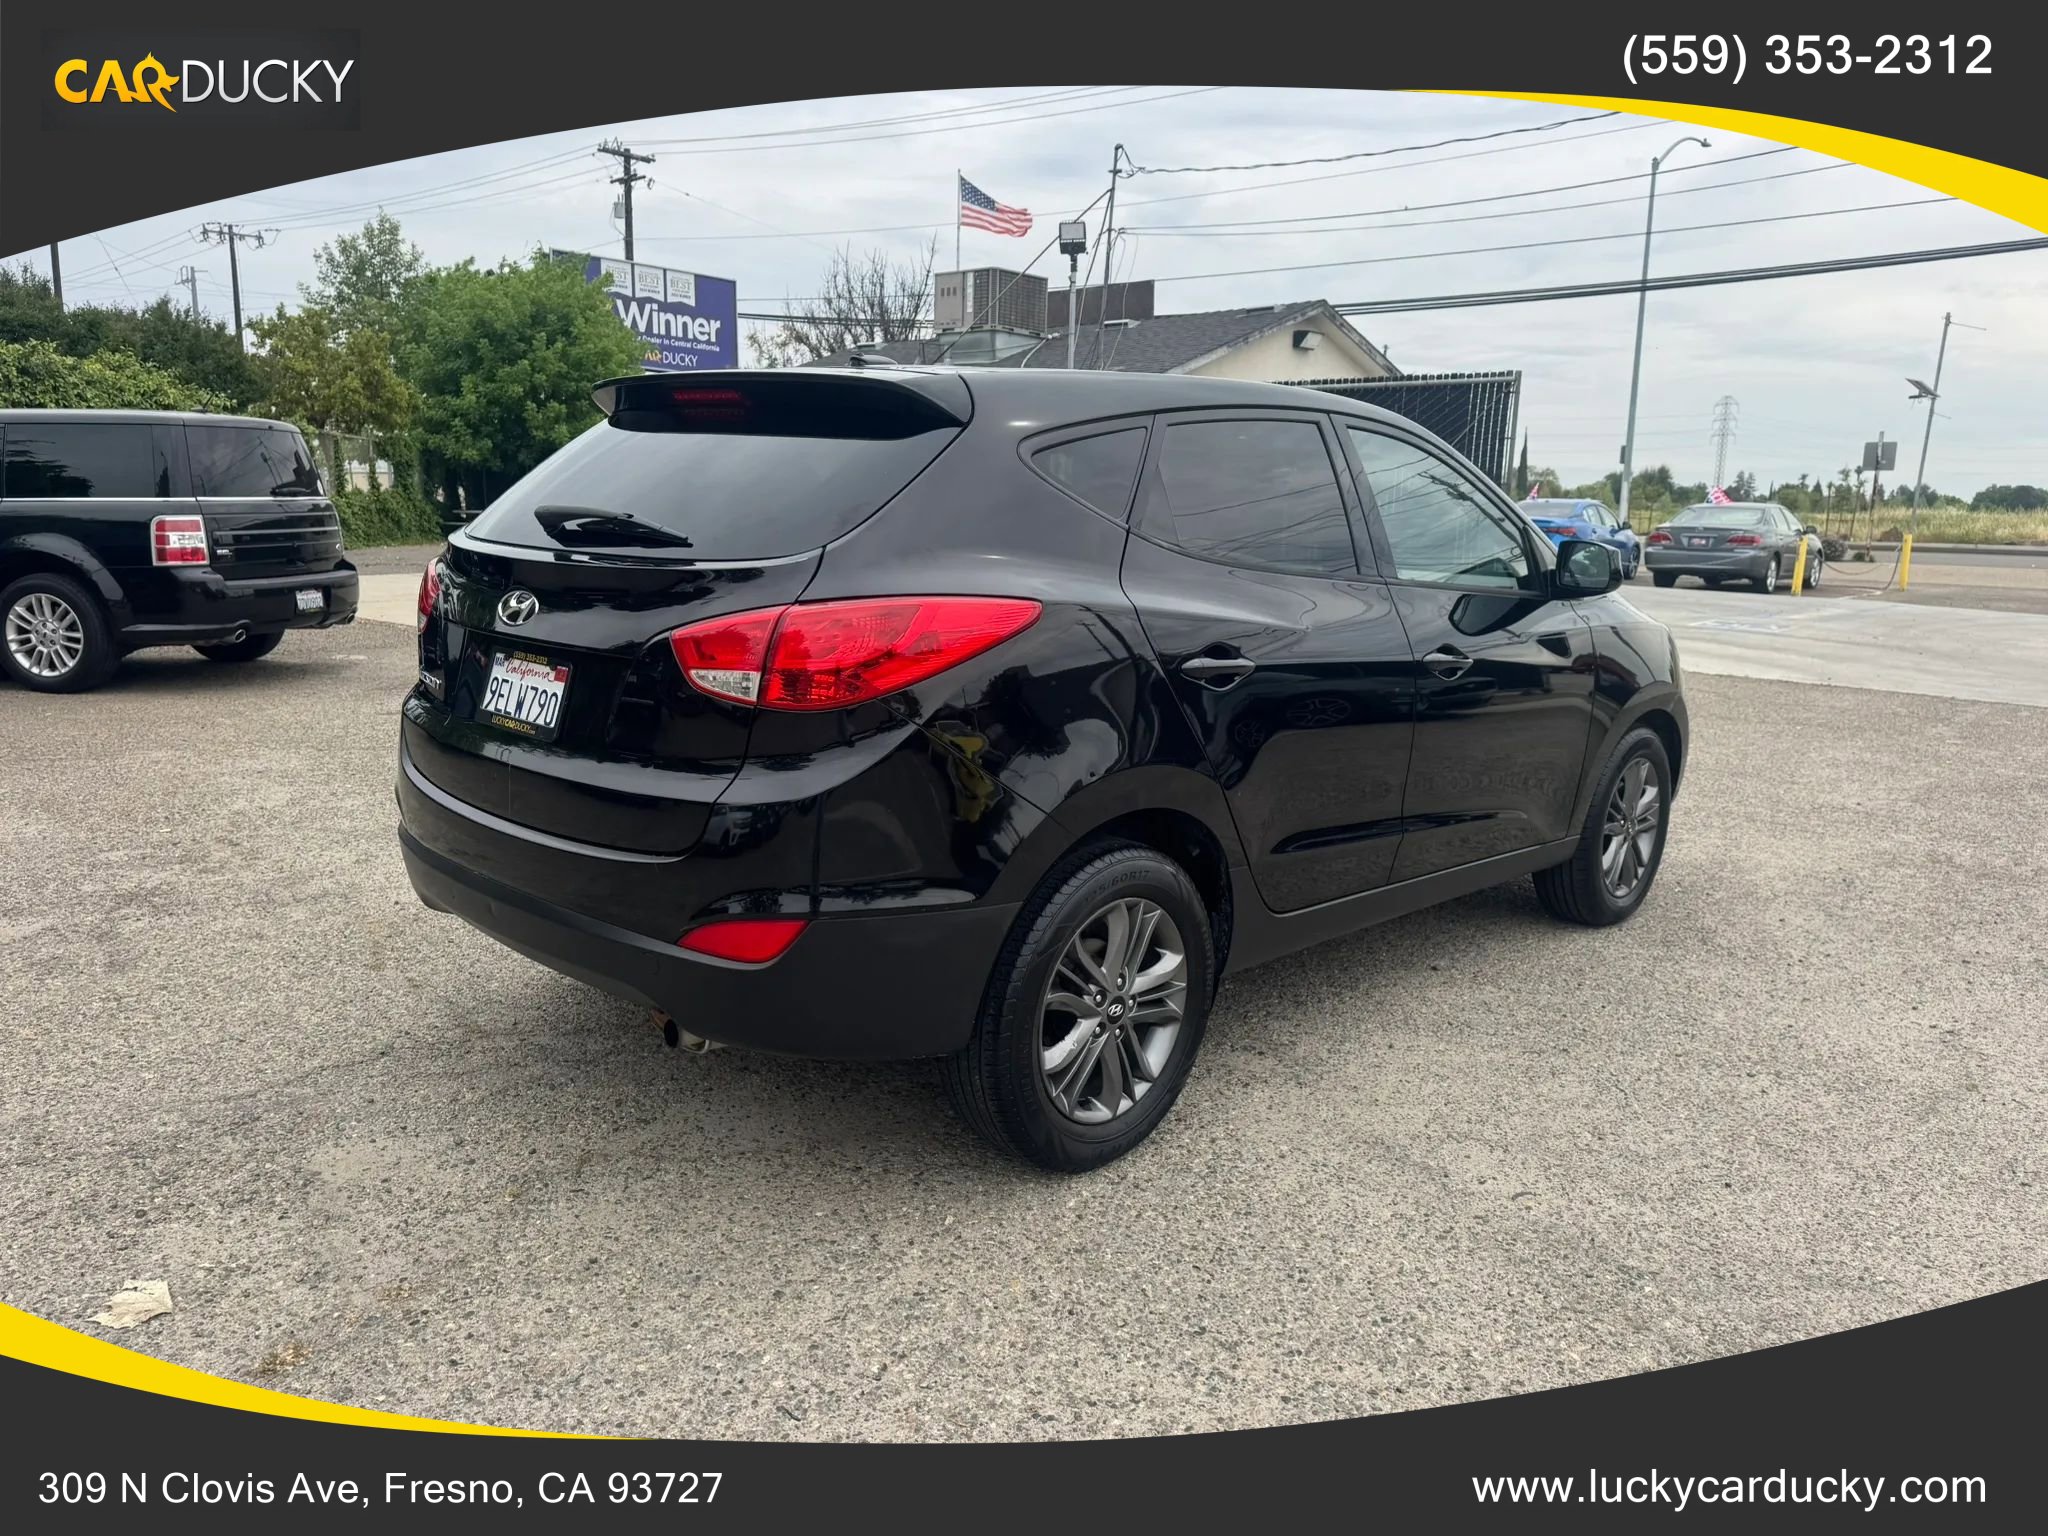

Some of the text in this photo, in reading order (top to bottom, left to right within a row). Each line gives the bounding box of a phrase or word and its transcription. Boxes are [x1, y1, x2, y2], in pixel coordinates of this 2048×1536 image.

[638, 272, 661, 286] BEST
[670, 278, 693, 291] BEST
[615, 298, 721, 342] Winner
[670, 339, 692, 349] Central
[692, 342, 720, 352] California
[505, 657, 551, 682] California
[484, 676, 560, 727] 9ELW790
